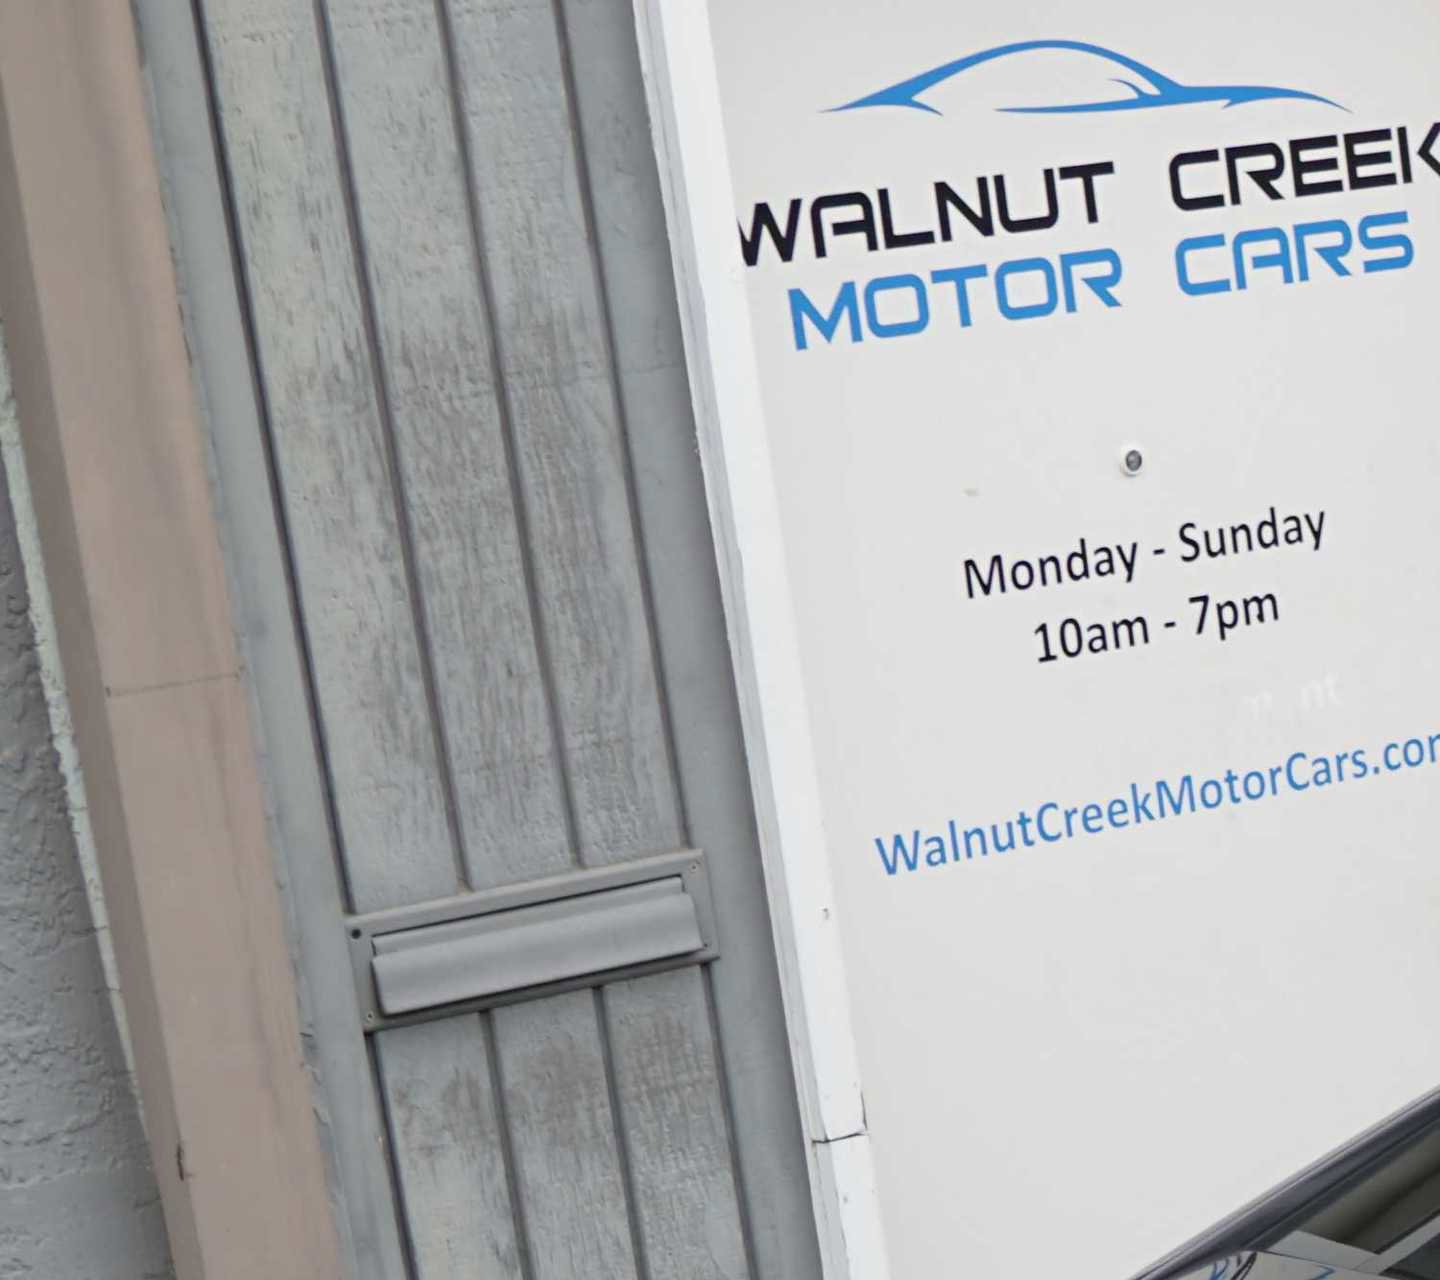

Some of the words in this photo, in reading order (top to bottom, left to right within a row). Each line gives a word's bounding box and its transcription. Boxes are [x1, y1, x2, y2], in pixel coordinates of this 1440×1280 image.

[737, 160, 1115, 267] WALNUT
[786, 247, 1123, 351] MOTOR
[1173, 209, 1416, 298] CARS
[962, 533, 1138, 600] Monday
[1178, 507, 1328, 564] Sunday
[1034, 611, 1151, 663] 10am
[1188, 586, 1280, 645] 7pm
